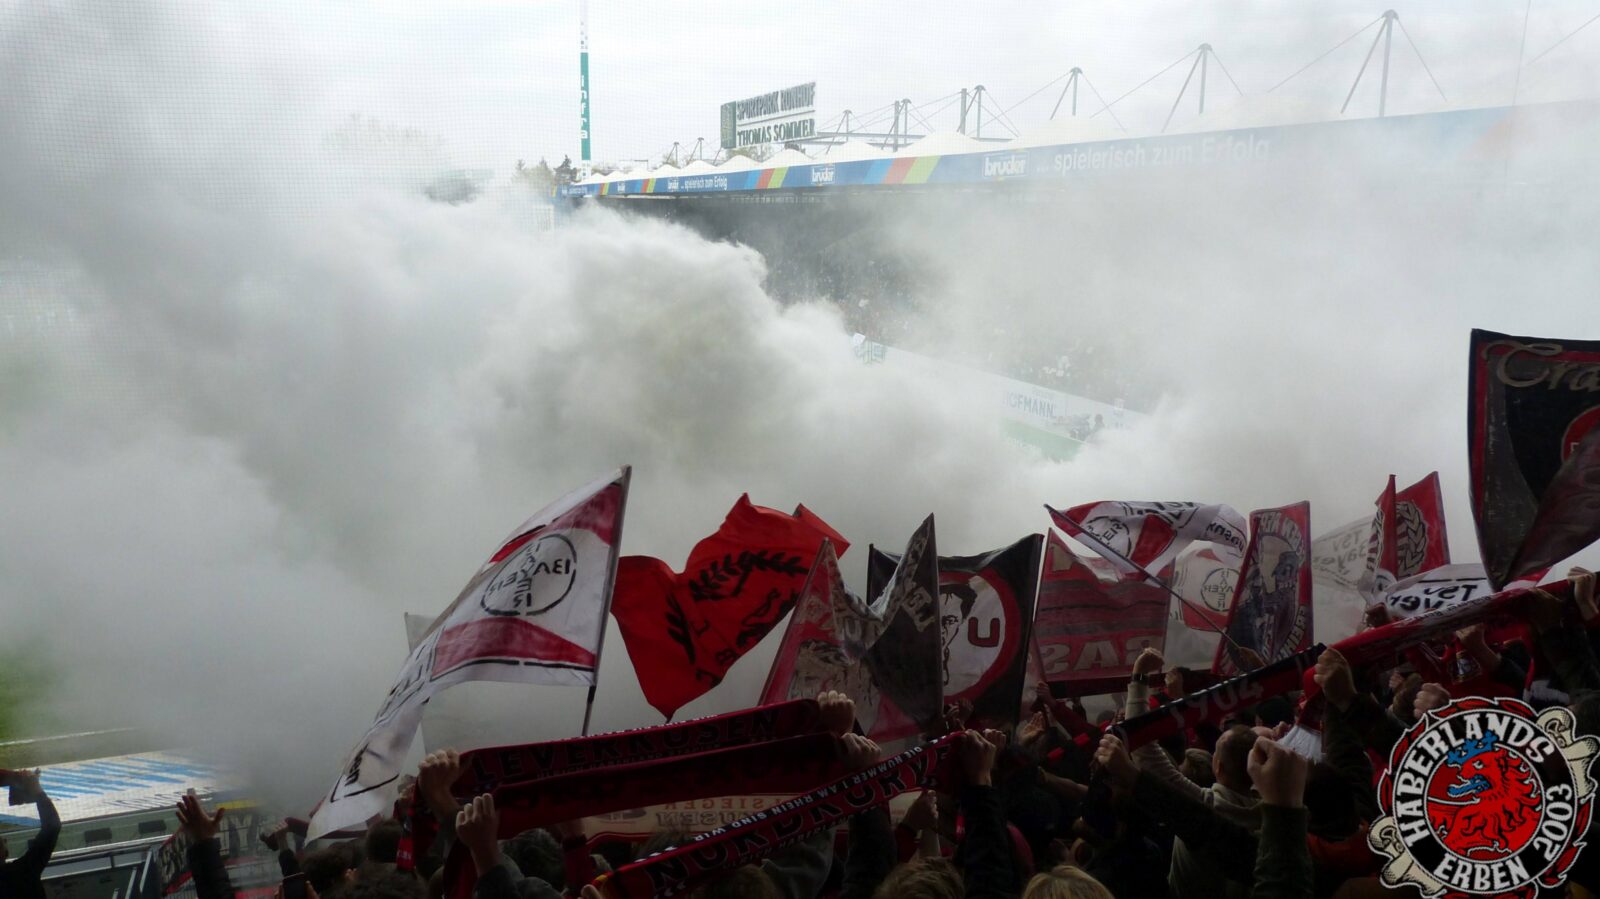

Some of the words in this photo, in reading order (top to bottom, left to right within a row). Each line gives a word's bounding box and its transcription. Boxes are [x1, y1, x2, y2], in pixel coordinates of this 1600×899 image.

[580, 75, 589, 139] infra
[737, 91, 780, 121] SPORTPARK
[737, 125, 772, 147] THOMAS
[773, 118, 817, 142] SOMMER
[983, 155, 1027, 177] bruder
[1053, 143, 1146, 177] spielerisch
[1153, 144, 1193, 166] zum
[811, 165, 835, 182] bruder
[472, 709, 782, 784] LEVERKUSEN
[904, 745, 923, 760] DIE
[853, 757, 904, 787] NUMMER
[816, 783, 839, 800] AM
[772, 794, 816, 817] RHEIN
[731, 810, 768, 830] SIND
[694, 826, 728, 842] WIR
